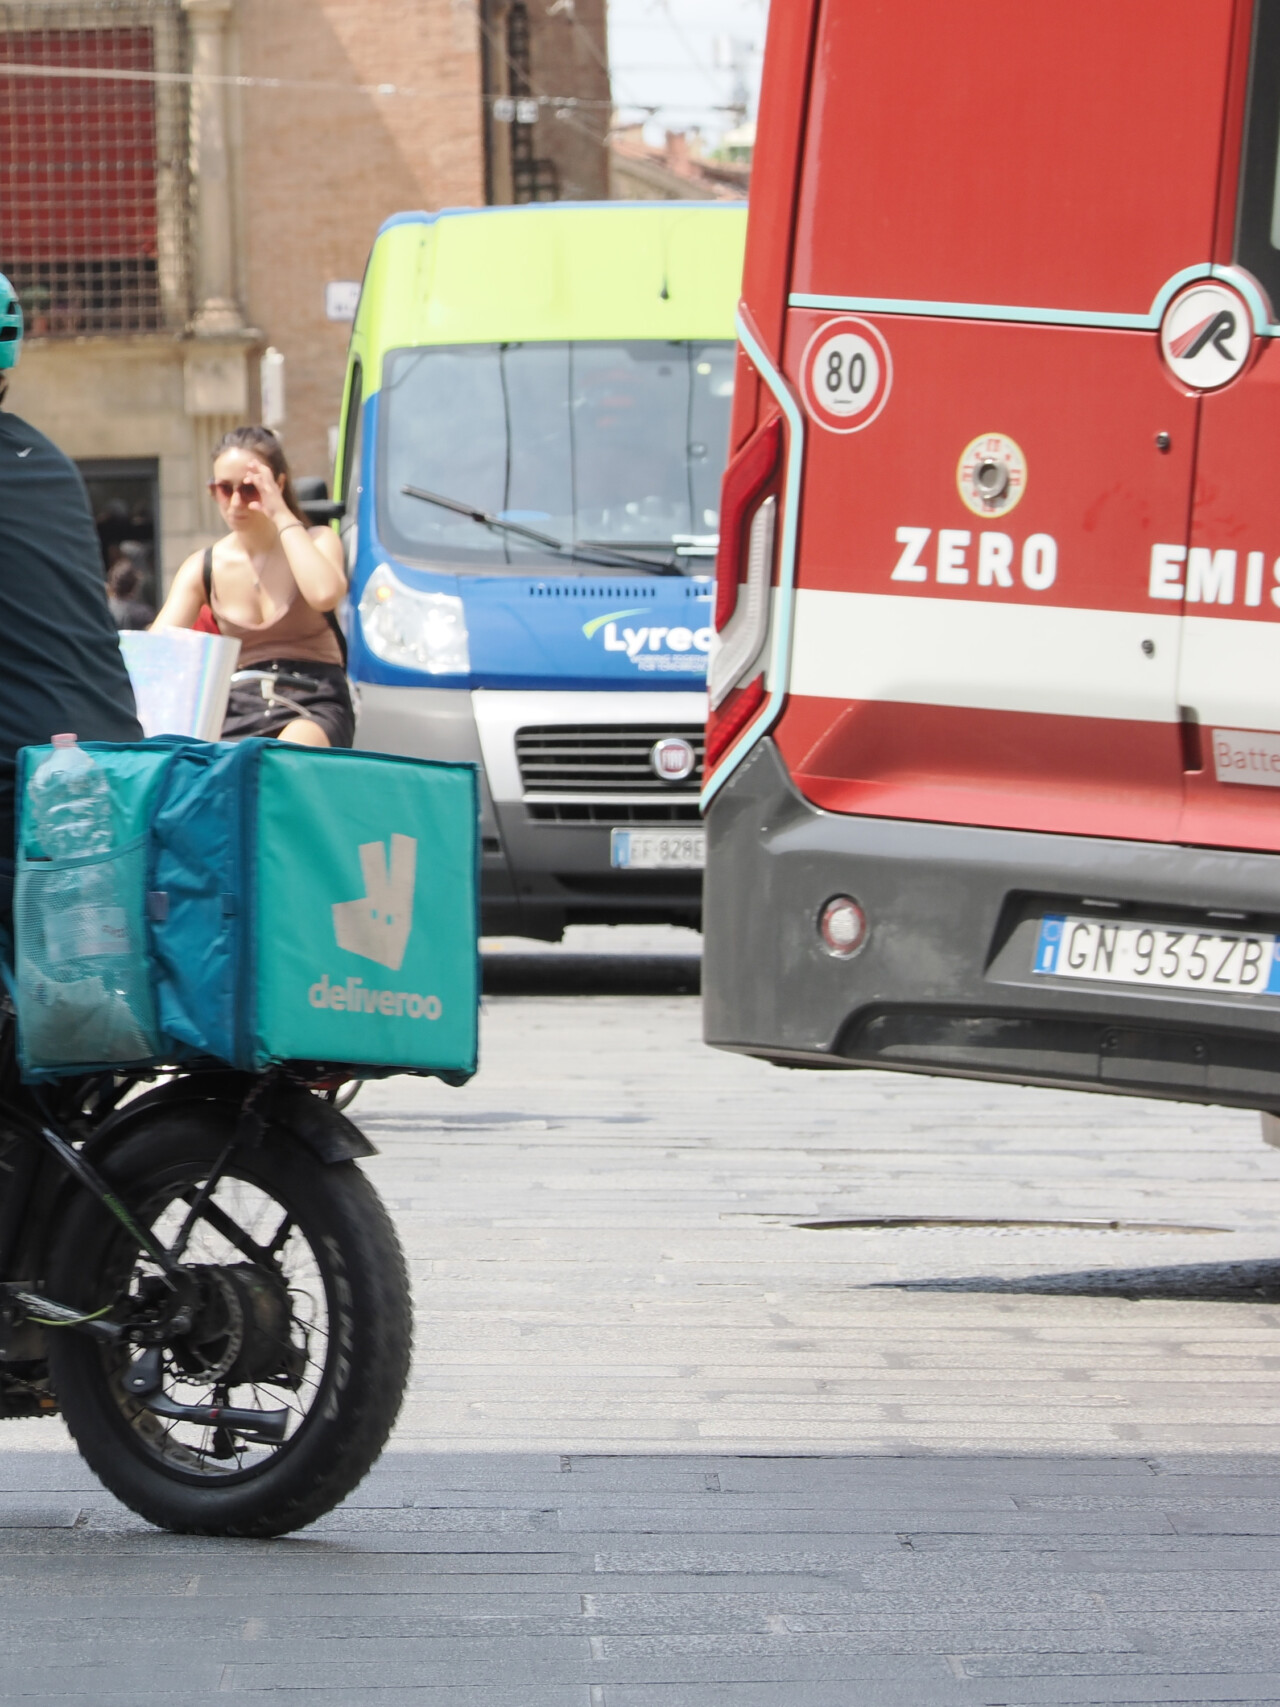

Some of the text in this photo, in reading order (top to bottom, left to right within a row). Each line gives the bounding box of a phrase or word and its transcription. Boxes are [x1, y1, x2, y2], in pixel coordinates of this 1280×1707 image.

[825, 350, 866, 394] 80
[890, 526, 1280, 609] ZERO EMI
[308, 973, 443, 1021] deliveroo
